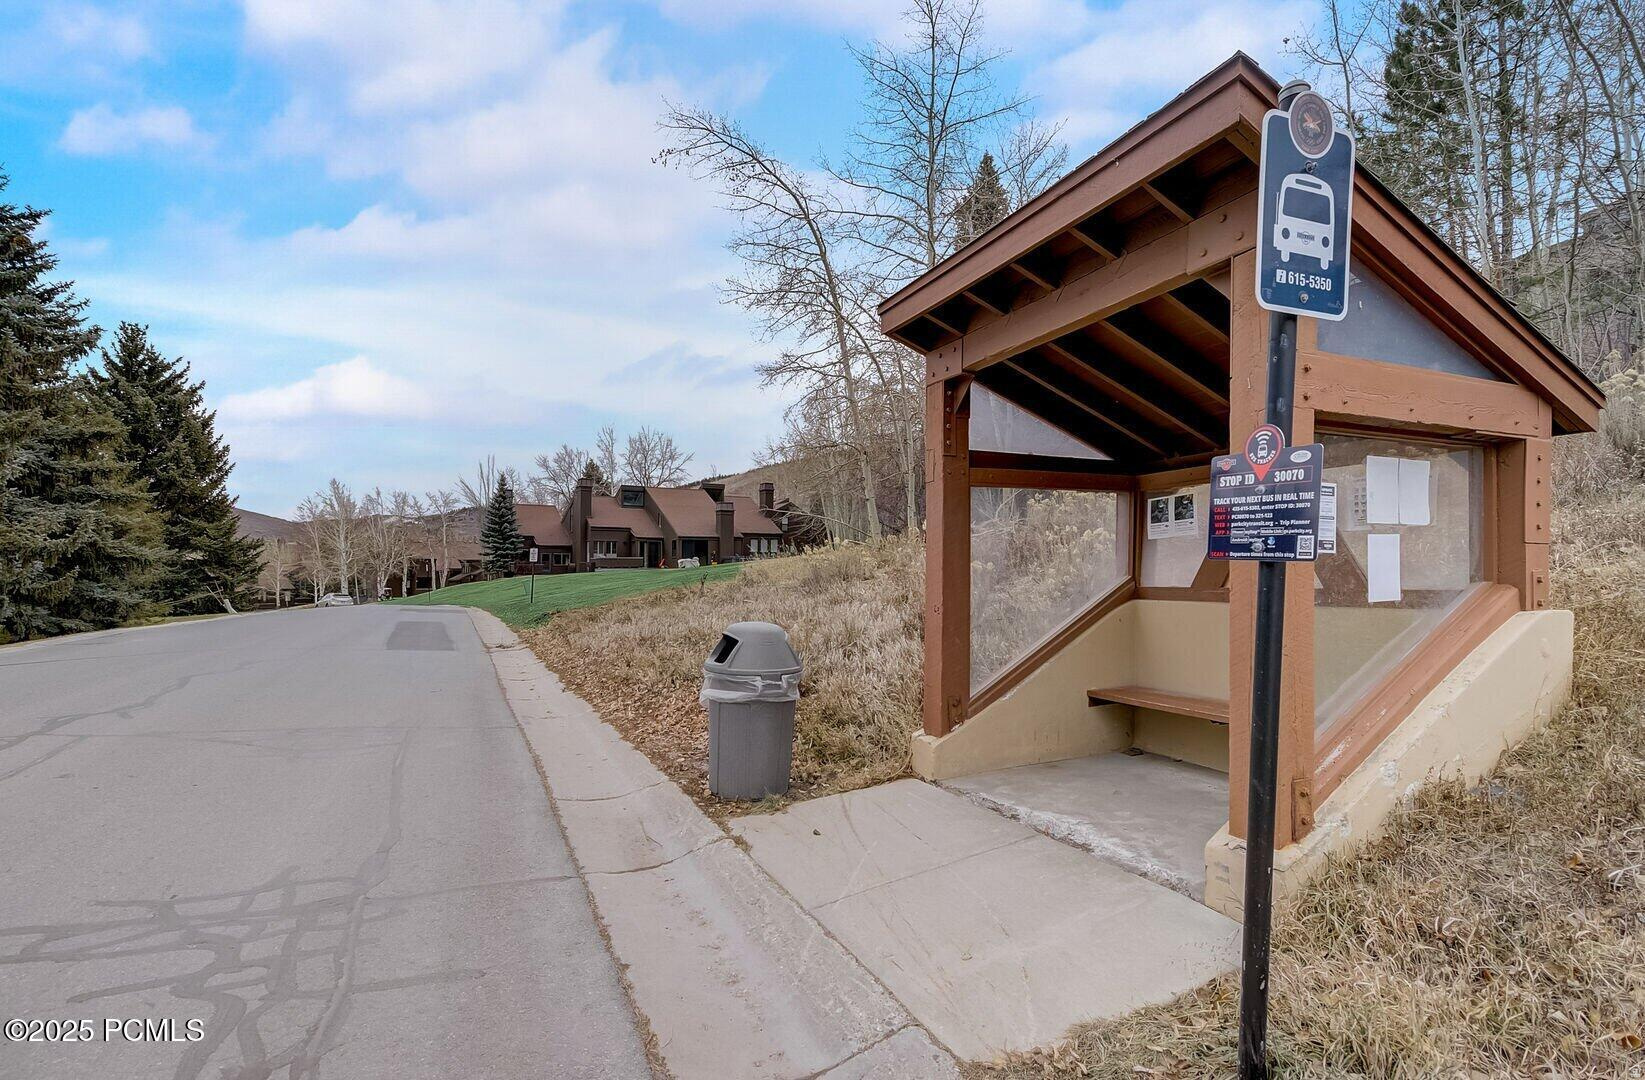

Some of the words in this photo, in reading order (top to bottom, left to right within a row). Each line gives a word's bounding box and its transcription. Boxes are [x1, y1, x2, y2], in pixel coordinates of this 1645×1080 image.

[1288, 271, 1332, 291] 615-5350
[1256, 450, 1277, 465] TRACKER
[1219, 475, 1241, 487] STOP
[1245, 474, 1255, 485] ID
[1274, 469, 1305, 483] 30070
[1282, 493, 1298, 501] REAL
